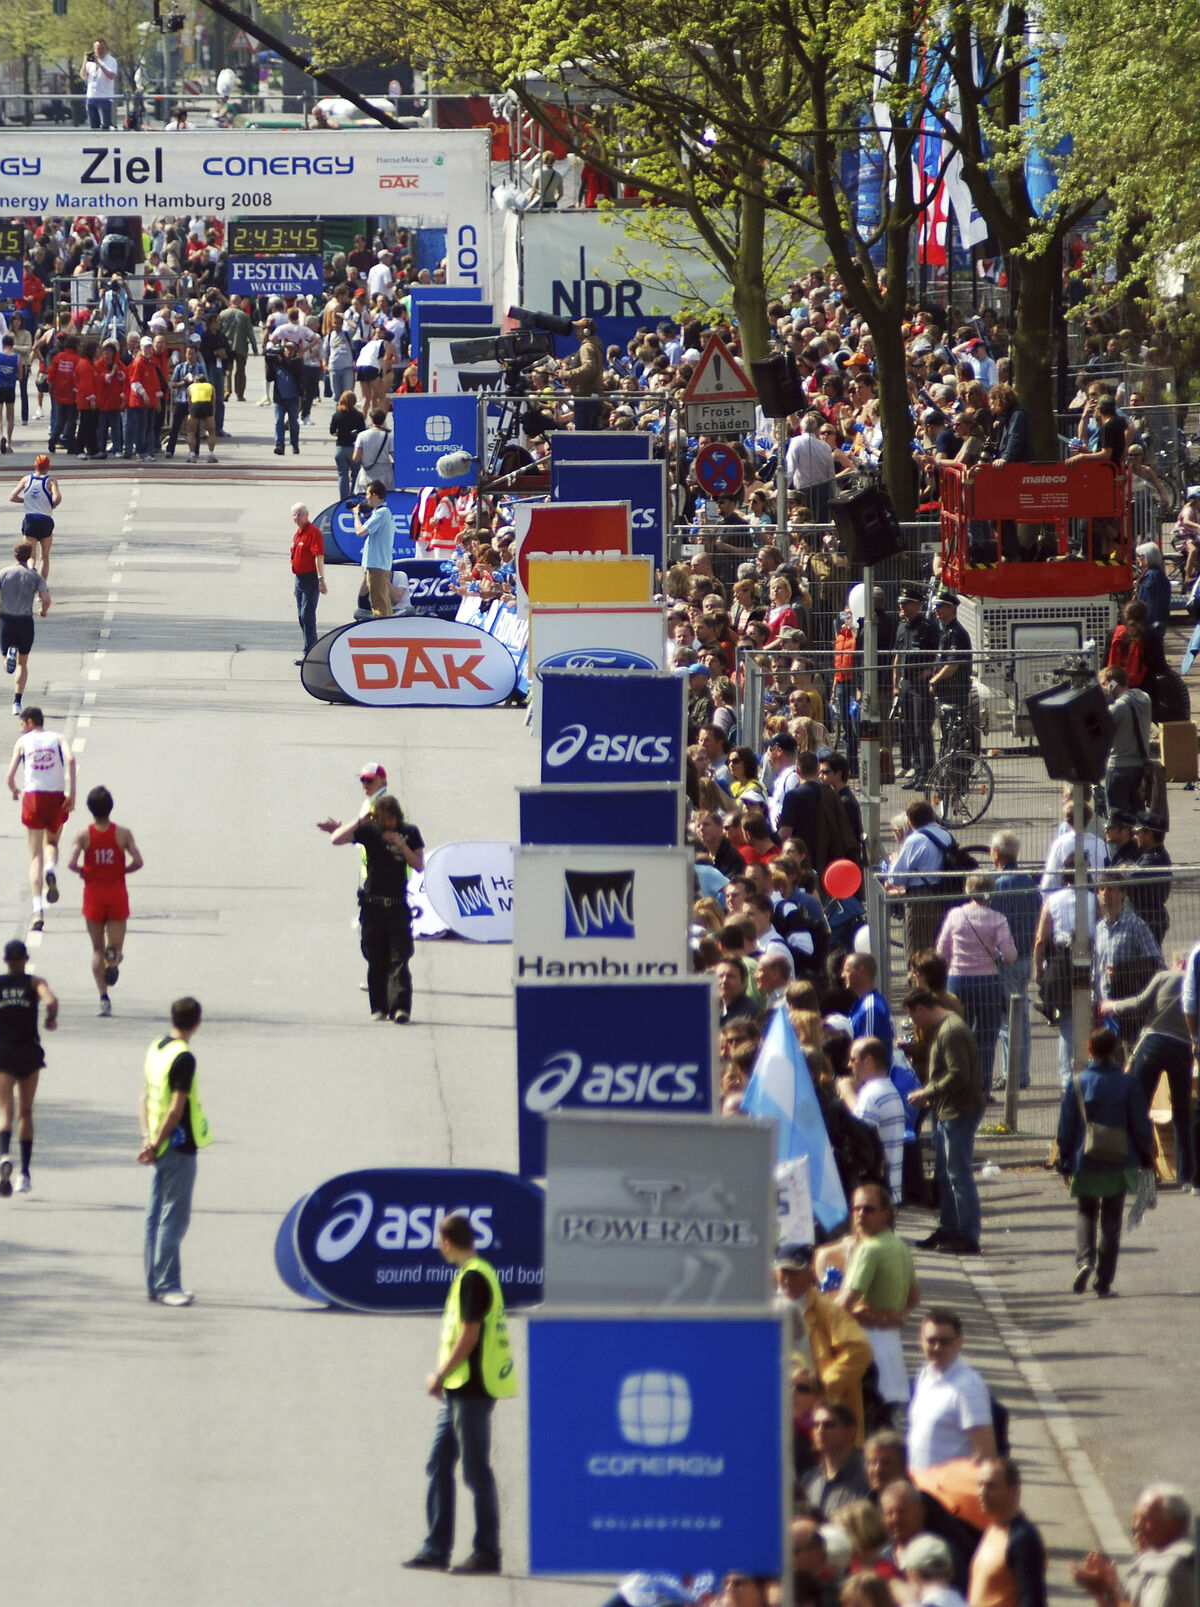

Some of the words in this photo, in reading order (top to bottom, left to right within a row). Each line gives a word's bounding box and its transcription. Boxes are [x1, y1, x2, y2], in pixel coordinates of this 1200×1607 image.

[81, 147, 163, 184] Ziel
[379, 174, 420, 188] DAK
[56, 193, 138, 208] Marathon
[145, 193, 225, 210] Hamburg
[232, 193, 272, 207] 2008
[234, 228, 319, 248] 2:43:45
[232, 262, 319, 281] FESTINA
[250, 282, 302, 292] WATCHES
[552, 280, 644, 317] NDR
[702, 407, 742, 418] Frost-
[696, 418, 750, 431] schäden
[1022, 475, 1067, 484] mateco
[348, 637, 494, 691] DAK
[95, 849, 115, 864] 112
[518, 956, 678, 976] Hamburg
[376, 1207, 493, 1250] asis
[562, 1216, 750, 1244] POWERADE
[376, 1265, 423, 1284] sound
[517, 1266, 546, 1284] bod
